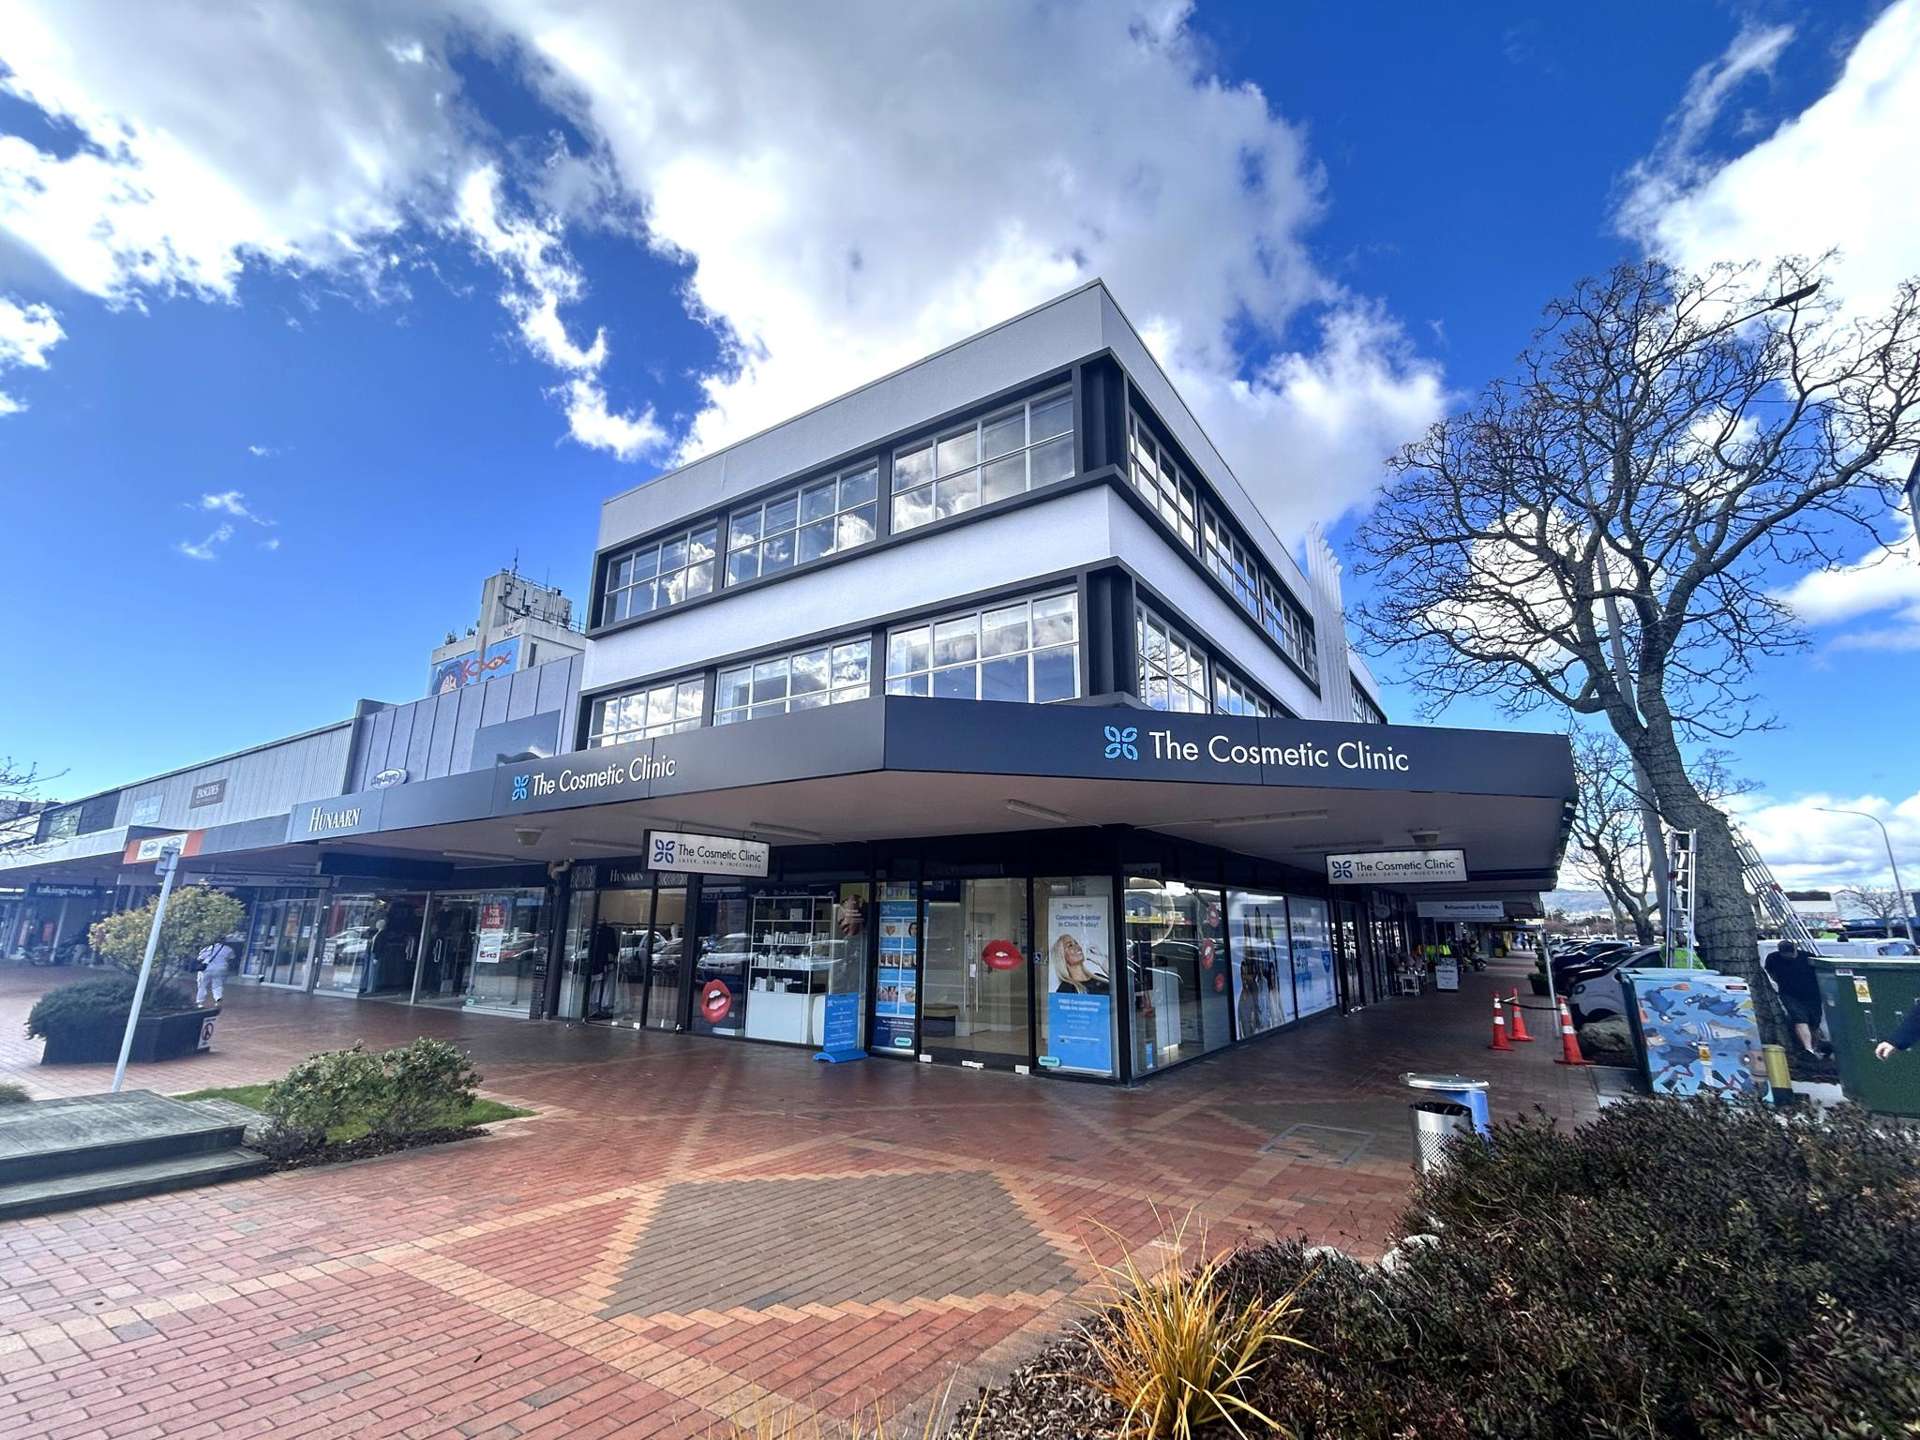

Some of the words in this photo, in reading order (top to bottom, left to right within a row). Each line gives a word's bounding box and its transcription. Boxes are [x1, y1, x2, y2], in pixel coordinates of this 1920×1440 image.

[1148, 730, 1199, 761] The
[1207, 735, 1329, 768] Cosmetic
[1337, 741, 1409, 771] Clinic
[533, 772, 555, 796] The
[559, 763, 625, 792] Cosmetic
[628, 754, 676, 782] Clinic
[308, 807, 361, 832] HUNAARN
[678, 843, 695, 857] The
[697, 846, 737, 860] Cosmetic
[738, 849, 761, 863] Clinic
[1355, 861, 1373, 872] The
[1375, 857, 1421, 871] Cosmetic
[1424, 858, 1455, 870] Clinic
